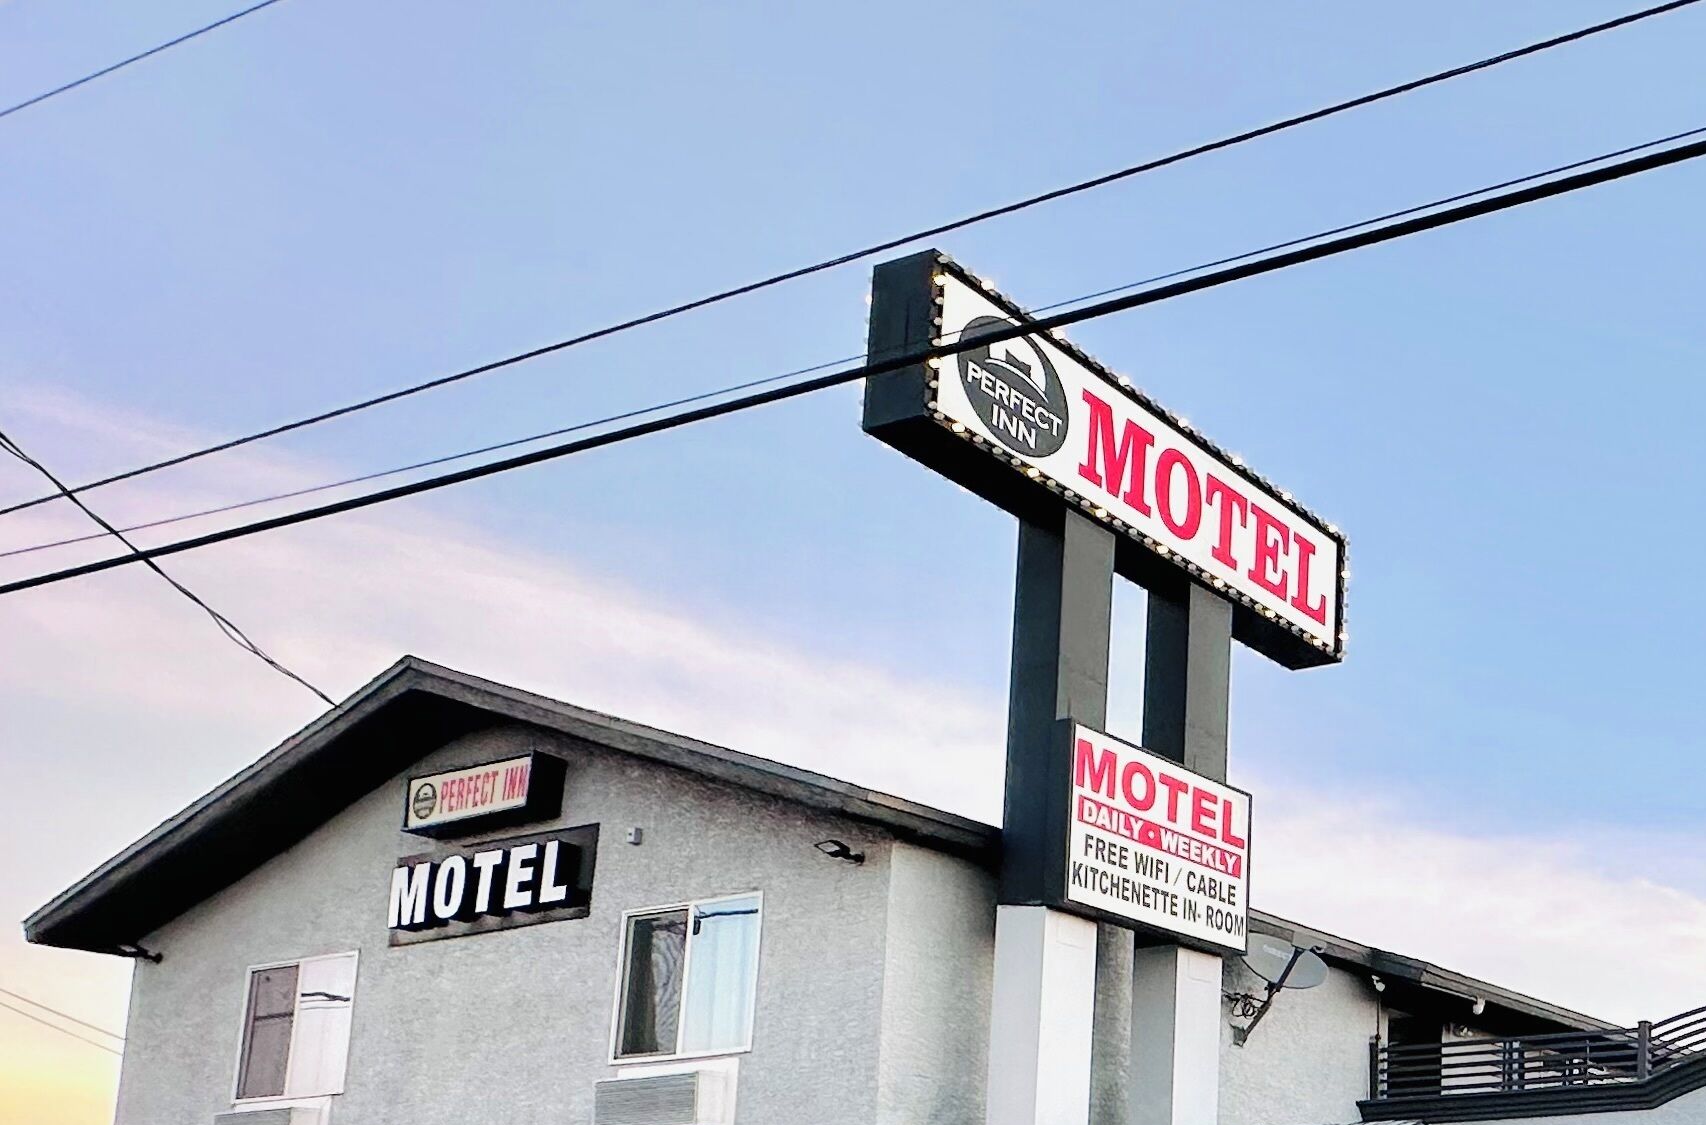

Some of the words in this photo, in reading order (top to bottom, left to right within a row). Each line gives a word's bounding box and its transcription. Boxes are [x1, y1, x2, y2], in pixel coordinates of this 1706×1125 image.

[966, 360, 1062, 437] PERFECT
[991, 403, 1037, 449] INN
[1078, 389, 1327, 626] MOTEL
[439, 770, 499, 814] PERFECT
[502, 764, 530, 801] INN
[1076, 738, 1245, 850] MOTEL
[1082, 800, 1144, 840] DAILY
[1159, 828, 1239, 876] WEEKLY
[1084, 834, 1129, 870] FREE
[1135, 852, 1169, 883] WIFI
[1186, 870, 1236, 906] CABLE
[387, 839, 568, 929] MOTEL
[1072, 861, 1178, 916] KITCHENETTE
[1205, 905, 1245, 937] ROOM
